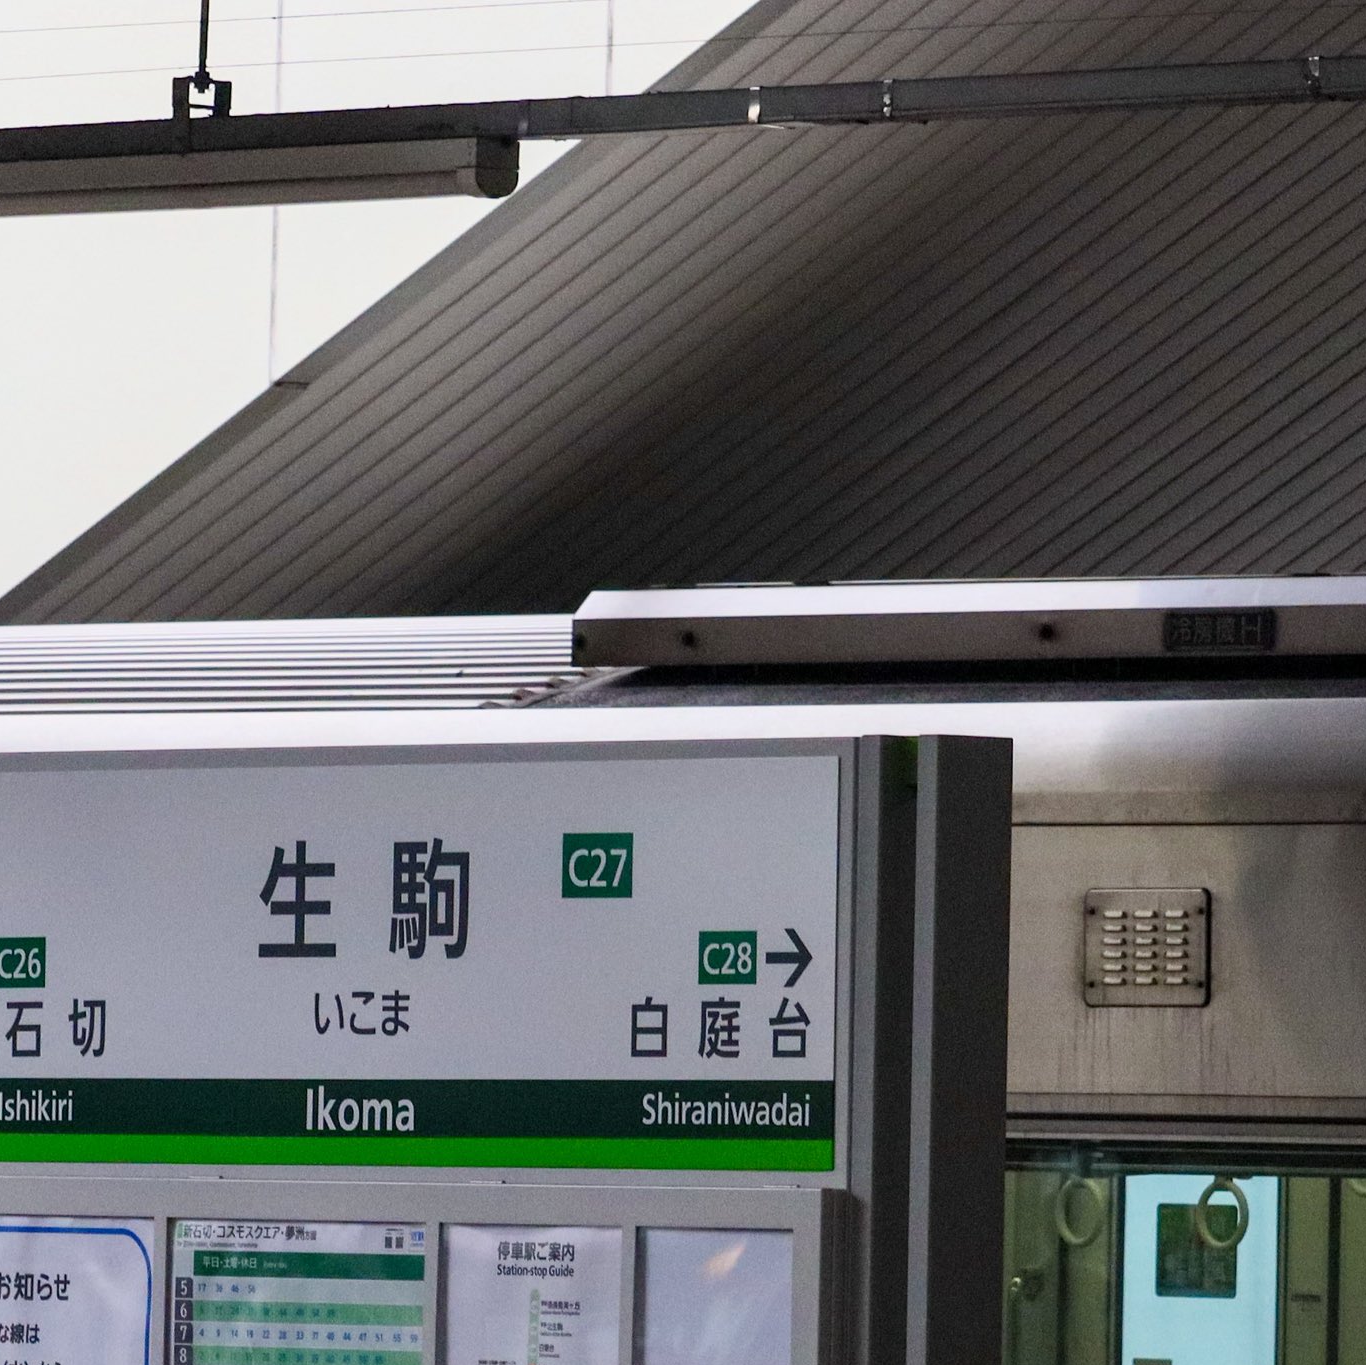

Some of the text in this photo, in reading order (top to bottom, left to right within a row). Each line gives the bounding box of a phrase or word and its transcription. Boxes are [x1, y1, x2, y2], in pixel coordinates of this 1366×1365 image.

[569, 849, 627, 887] C27
[259, 838, 470, 959] 生駒
[703, 942, 751, 974] C28
[315, 990, 410, 1036] いこま
[631, 997, 810, 1058] 白庭台
[306, 1086, 414, 1131] Ikoma
[643, 1092, 810, 1126] Shiraniwadai
[497, 1241, 575, 1261] 停車駅ご案内
[181, 1280, 187, 1295] 5
[497, 1264, 575, 1279] Station-stop Guide
[180, 1303, 187, 1318] 6
[180, 1325, 187, 1340] 7
[180, 1348, 187, 1363] 8
